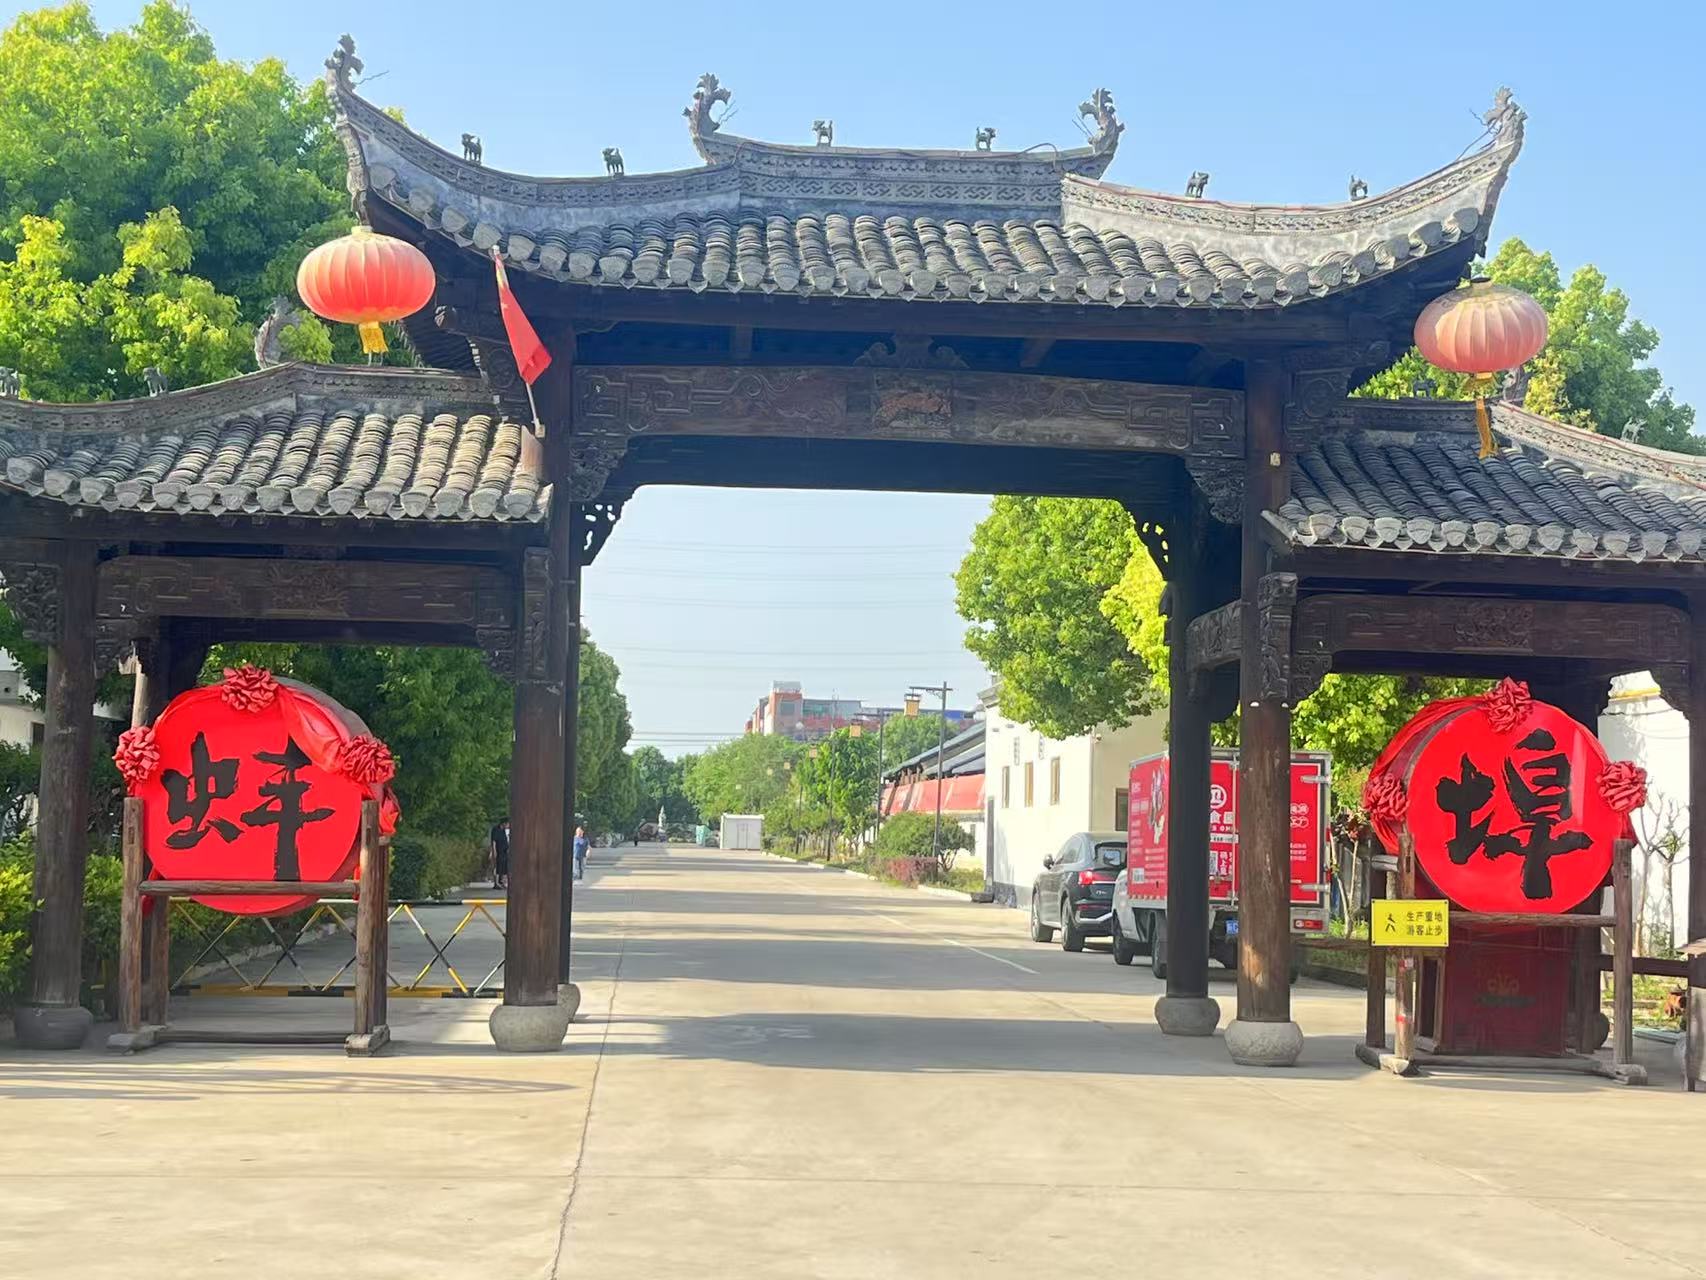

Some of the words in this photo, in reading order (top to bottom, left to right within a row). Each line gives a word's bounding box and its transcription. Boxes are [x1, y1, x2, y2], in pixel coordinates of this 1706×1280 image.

[1436, 728, 1594, 899] 埠
[1406, 911, 1443, 922] 生产重地
[1406, 925, 1443, 936] 游客止步
